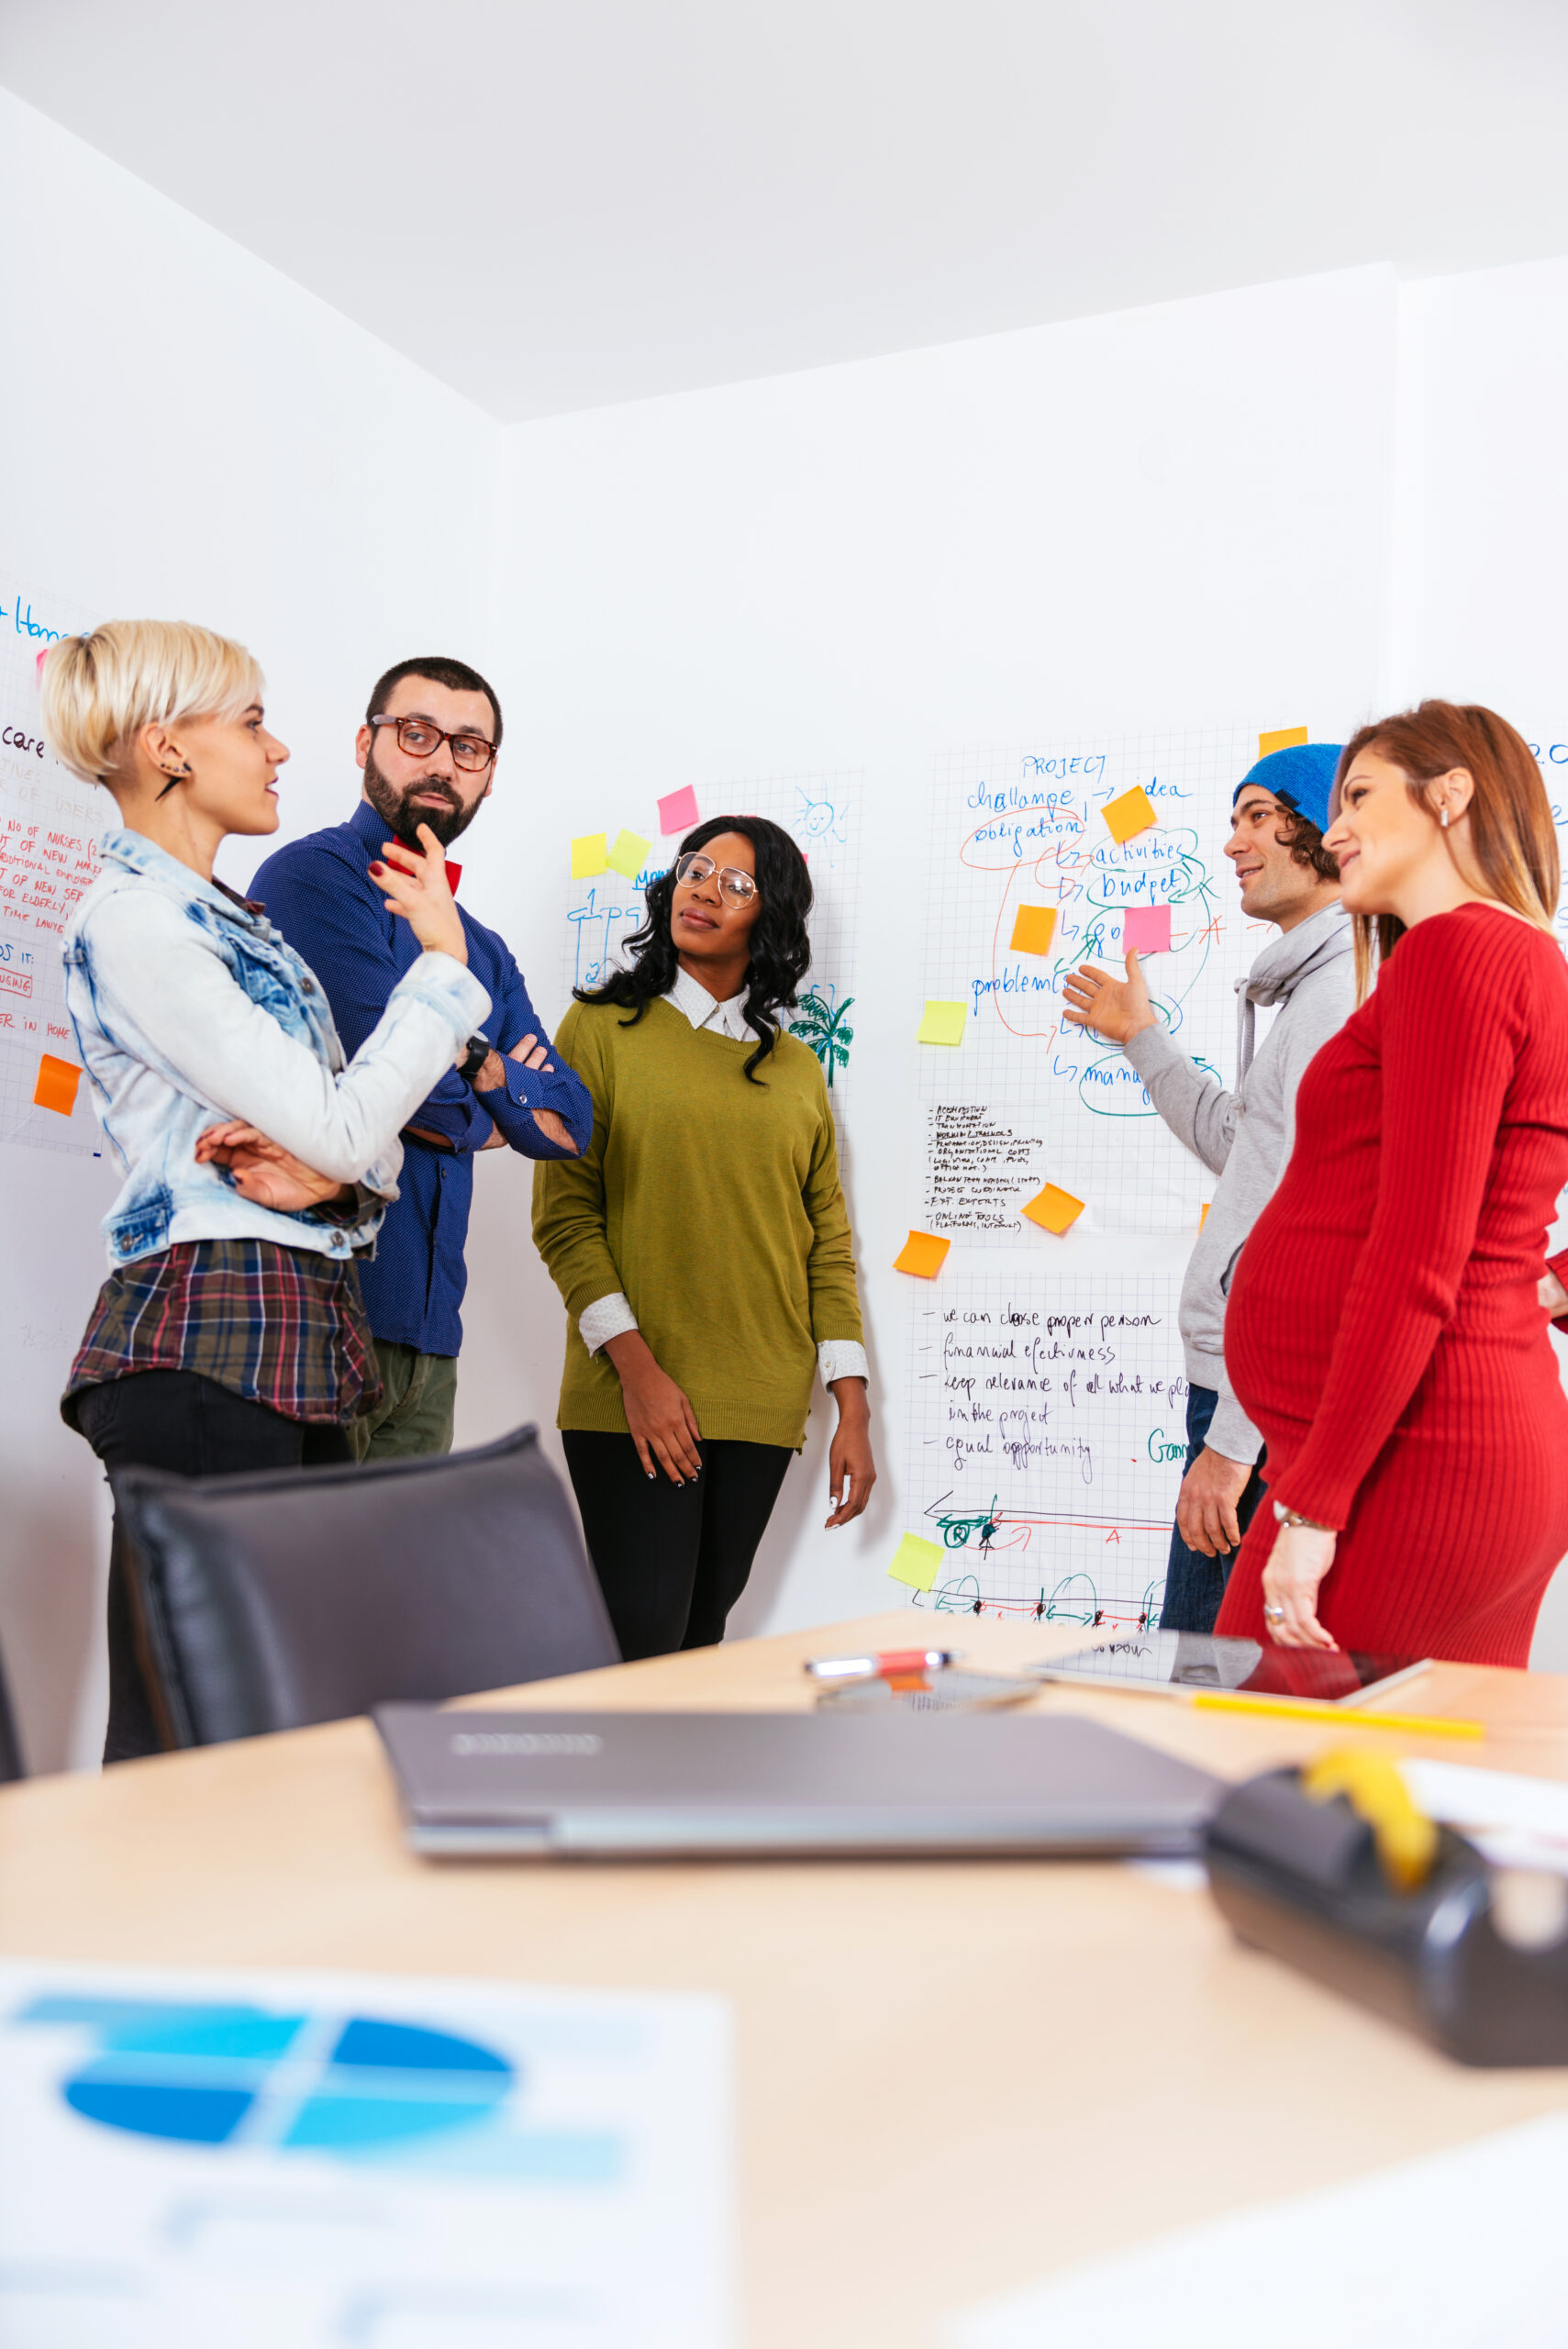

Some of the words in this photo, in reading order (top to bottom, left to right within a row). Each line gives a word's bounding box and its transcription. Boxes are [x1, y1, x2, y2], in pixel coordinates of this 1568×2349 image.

[1022, 755, 1107, 784] PROJECT
[1138, 776, 1193, 797] dea
[975, 818, 1086, 857] obligation
[43, 849, 68, 864] NEW
[1103, 869, 1181, 907] budget
[47, 1022, 71, 1041] HOME
[943, 1308, 959, 1323] we
[963, 1312, 991, 1323] can
[1047, 1313, 1094, 1338] proper
[1100, 1314, 1162, 1341] person
[943, 1331, 1018, 1371] financial
[1108, 1373, 1144, 1394] what
[1149, 1380, 1166, 1394] we
[999, 1401, 1055, 1445] project
